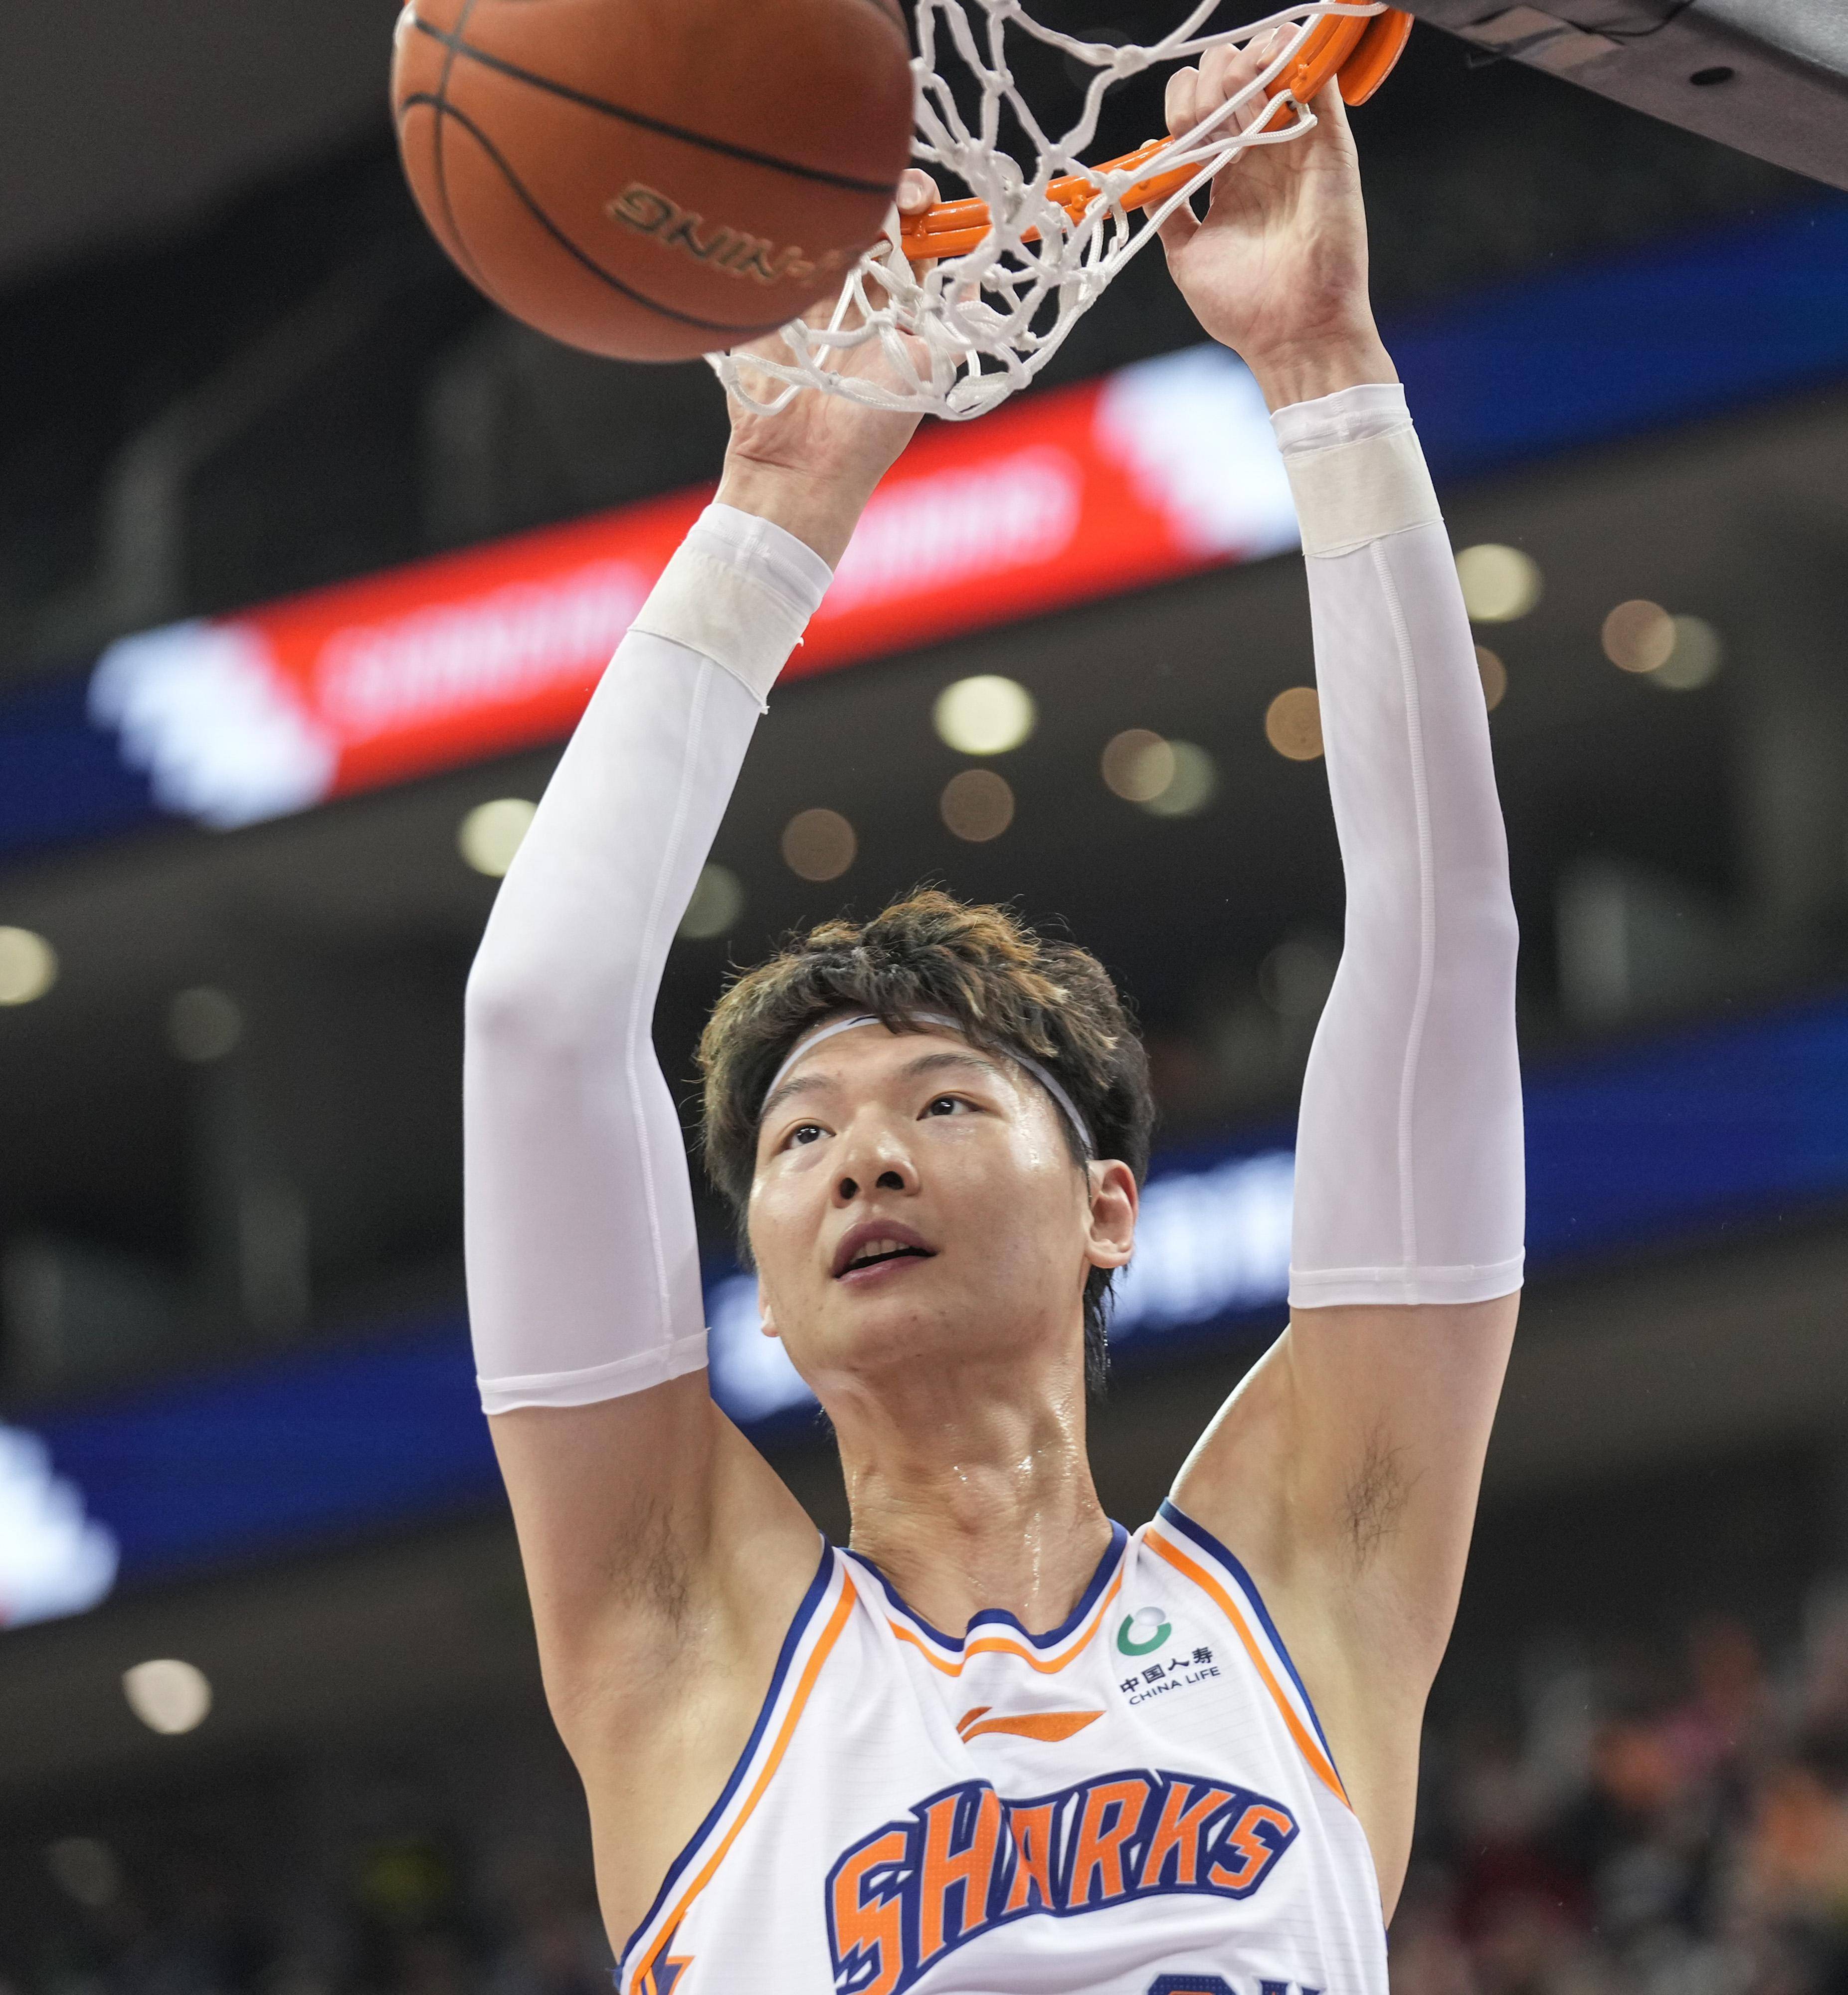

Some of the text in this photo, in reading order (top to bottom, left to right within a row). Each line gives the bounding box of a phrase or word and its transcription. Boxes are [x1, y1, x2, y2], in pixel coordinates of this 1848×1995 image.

[1120, 1647, 1213, 1693] 中国人寿
[1129, 1666, 1221, 1705] CHINA LIFE
[825, 1769, 1299, 1995] SHARKS
